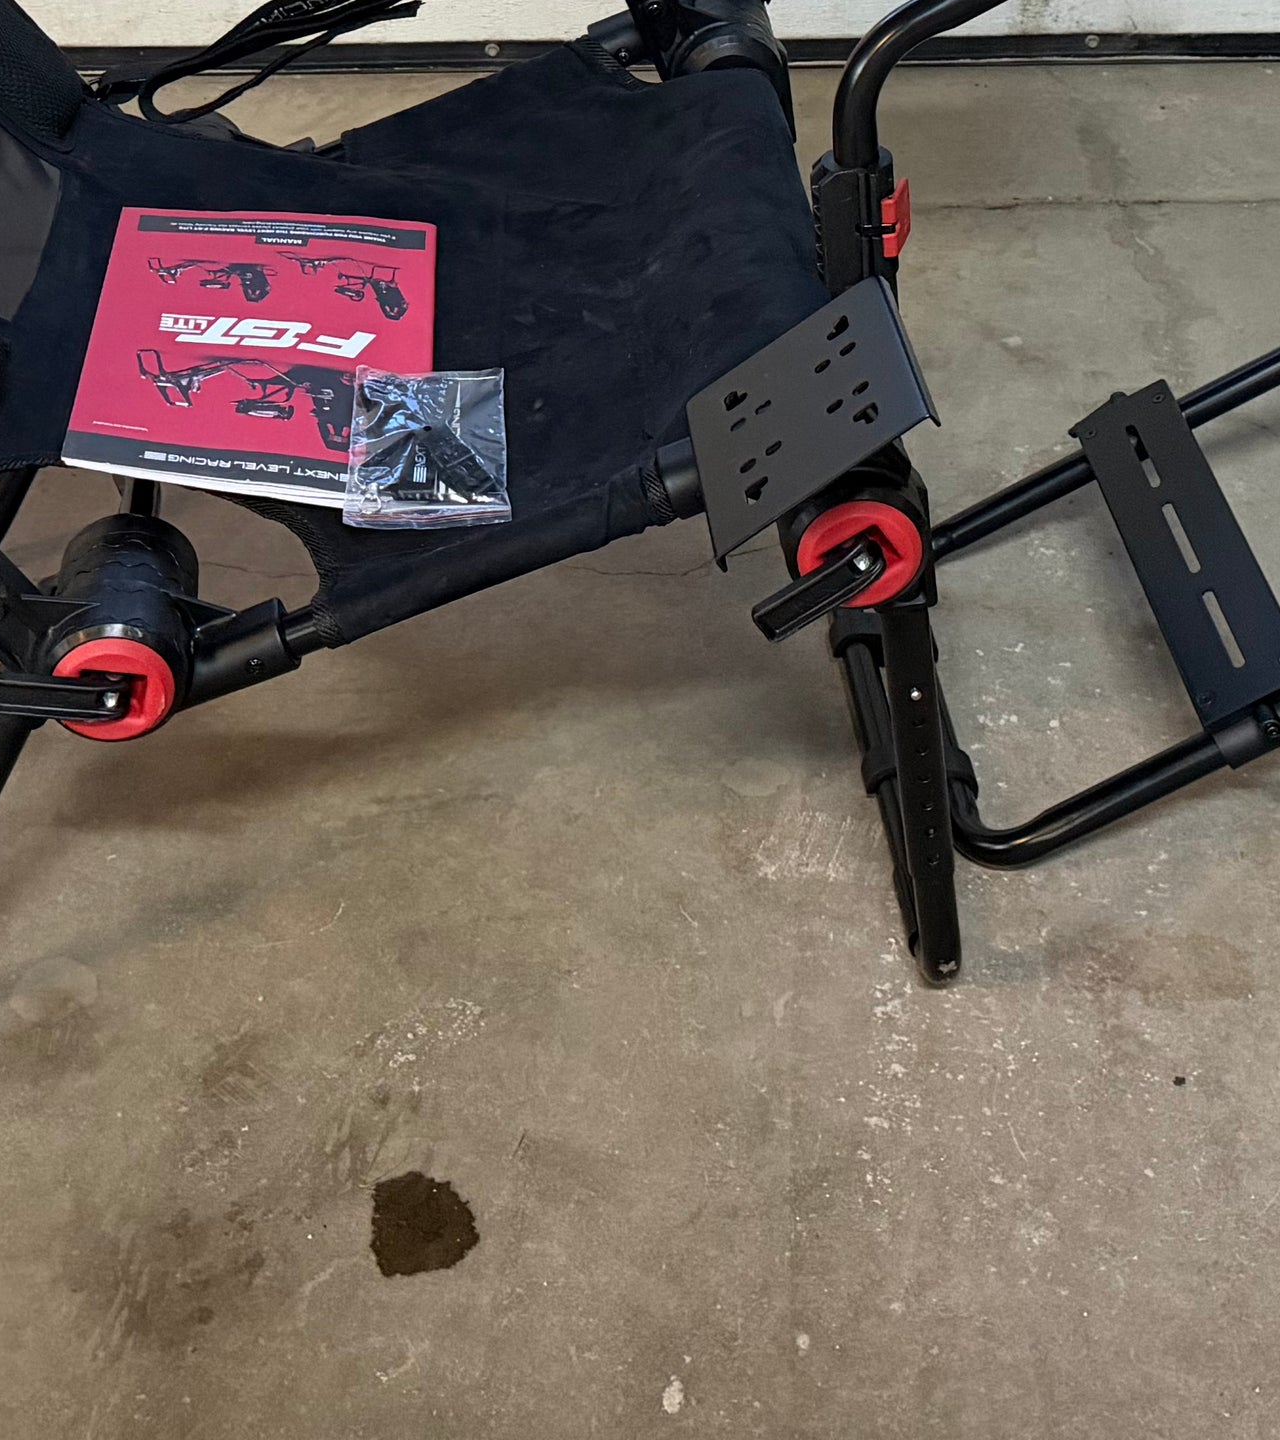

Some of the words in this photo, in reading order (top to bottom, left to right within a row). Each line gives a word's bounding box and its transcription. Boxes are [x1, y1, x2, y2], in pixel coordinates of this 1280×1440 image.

[261, 237, 302, 245] MANUAL
[159, 314, 207, 331] LITE
[168, 454, 231, 468] RACING
[234, 461, 290, 474] LEVEL
[293, 468, 339, 481] NEXT
